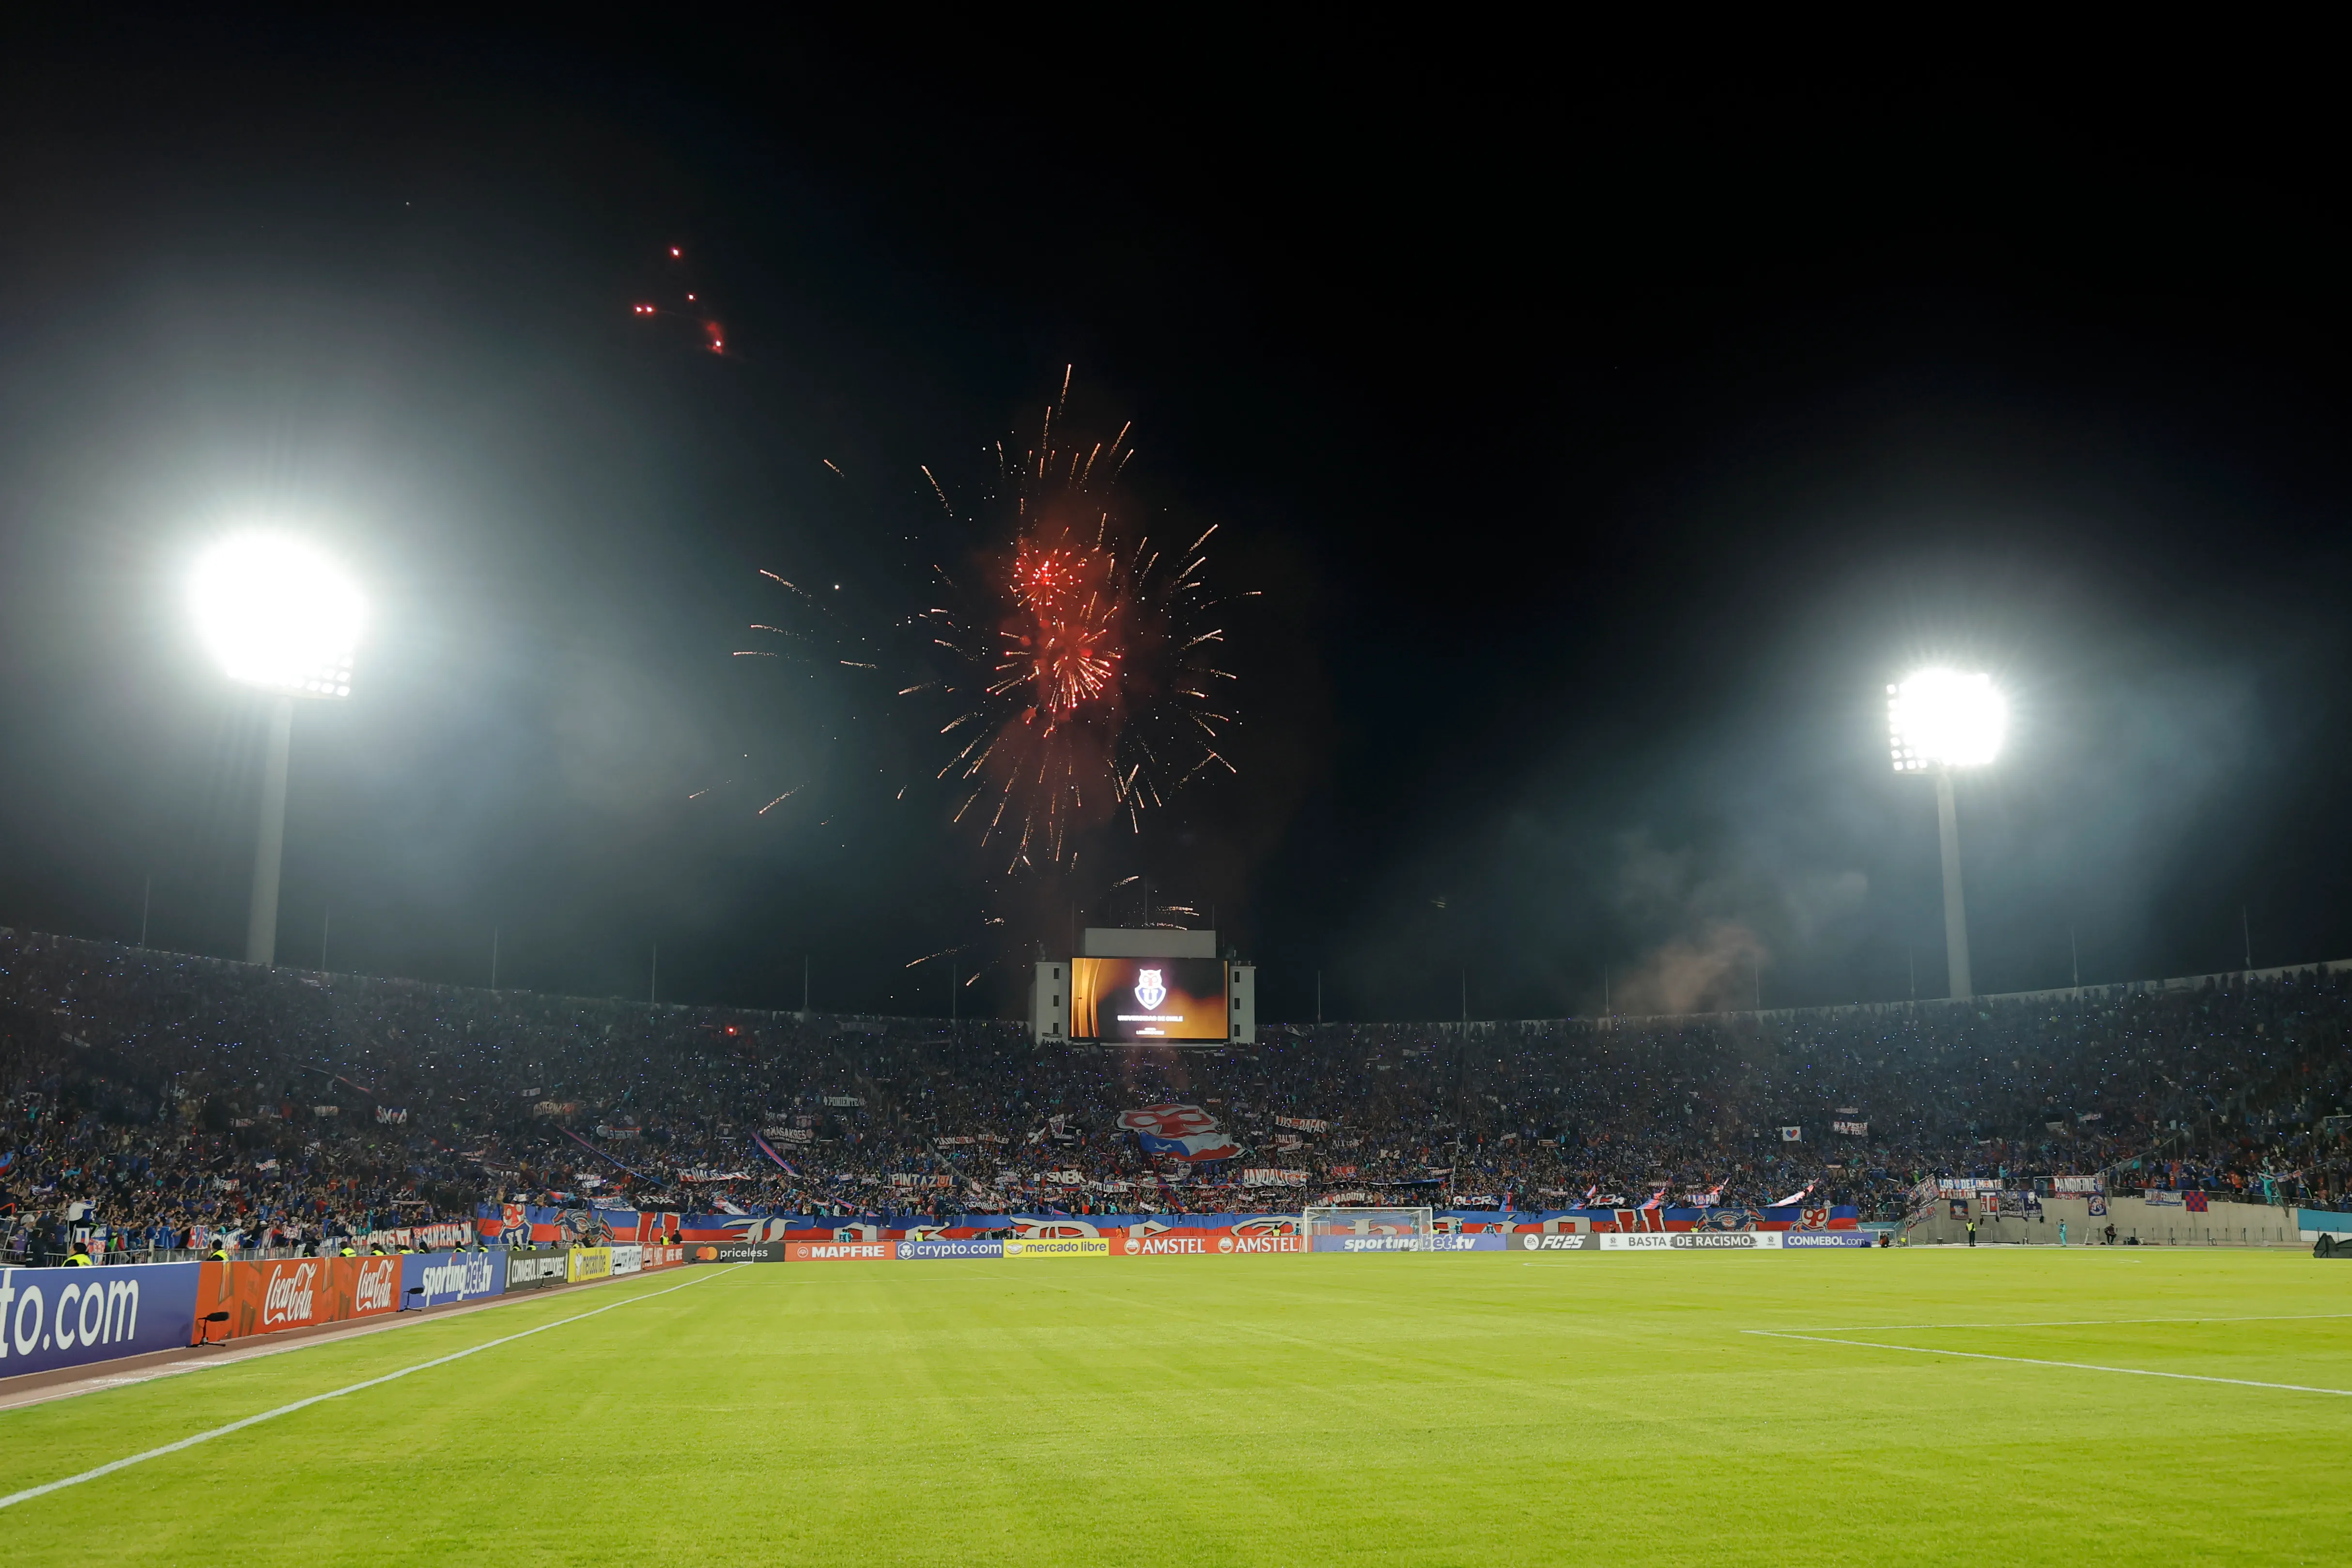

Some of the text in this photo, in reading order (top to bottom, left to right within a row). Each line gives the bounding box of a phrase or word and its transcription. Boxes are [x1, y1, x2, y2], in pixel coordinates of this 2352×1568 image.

[1275, 1116, 1292, 1128] LOS
[978, 1134, 1009, 1144] RITALES
[1278, 1134, 1296, 1144] SALTO
[1046, 1171, 1086, 1184] SNBK
[1939, 1179, 1976, 1189] LOS DEL
[422, 1222, 472, 1246] SAN RAMON
[1142, 1239, 1206, 1254] AMSTEL
[1235, 1237, 1297, 1252] AMSTEL
[1345, 1234, 1475, 1251] sportingbet.tv
[1629, 1236, 1751, 1246] BASTA DE RACISMO
[1788, 1237, 1865, 1246] CONMEBOL.com
[720, 1248, 768, 1258] priceless
[812, 1245, 884, 1258] MAPFRE
[917, 1243, 1002, 1258] crypto.com
[1026, 1242, 1106, 1253] mercado libre
[512, 1257, 565, 1283] CONMEBOL LIBERTADORES
